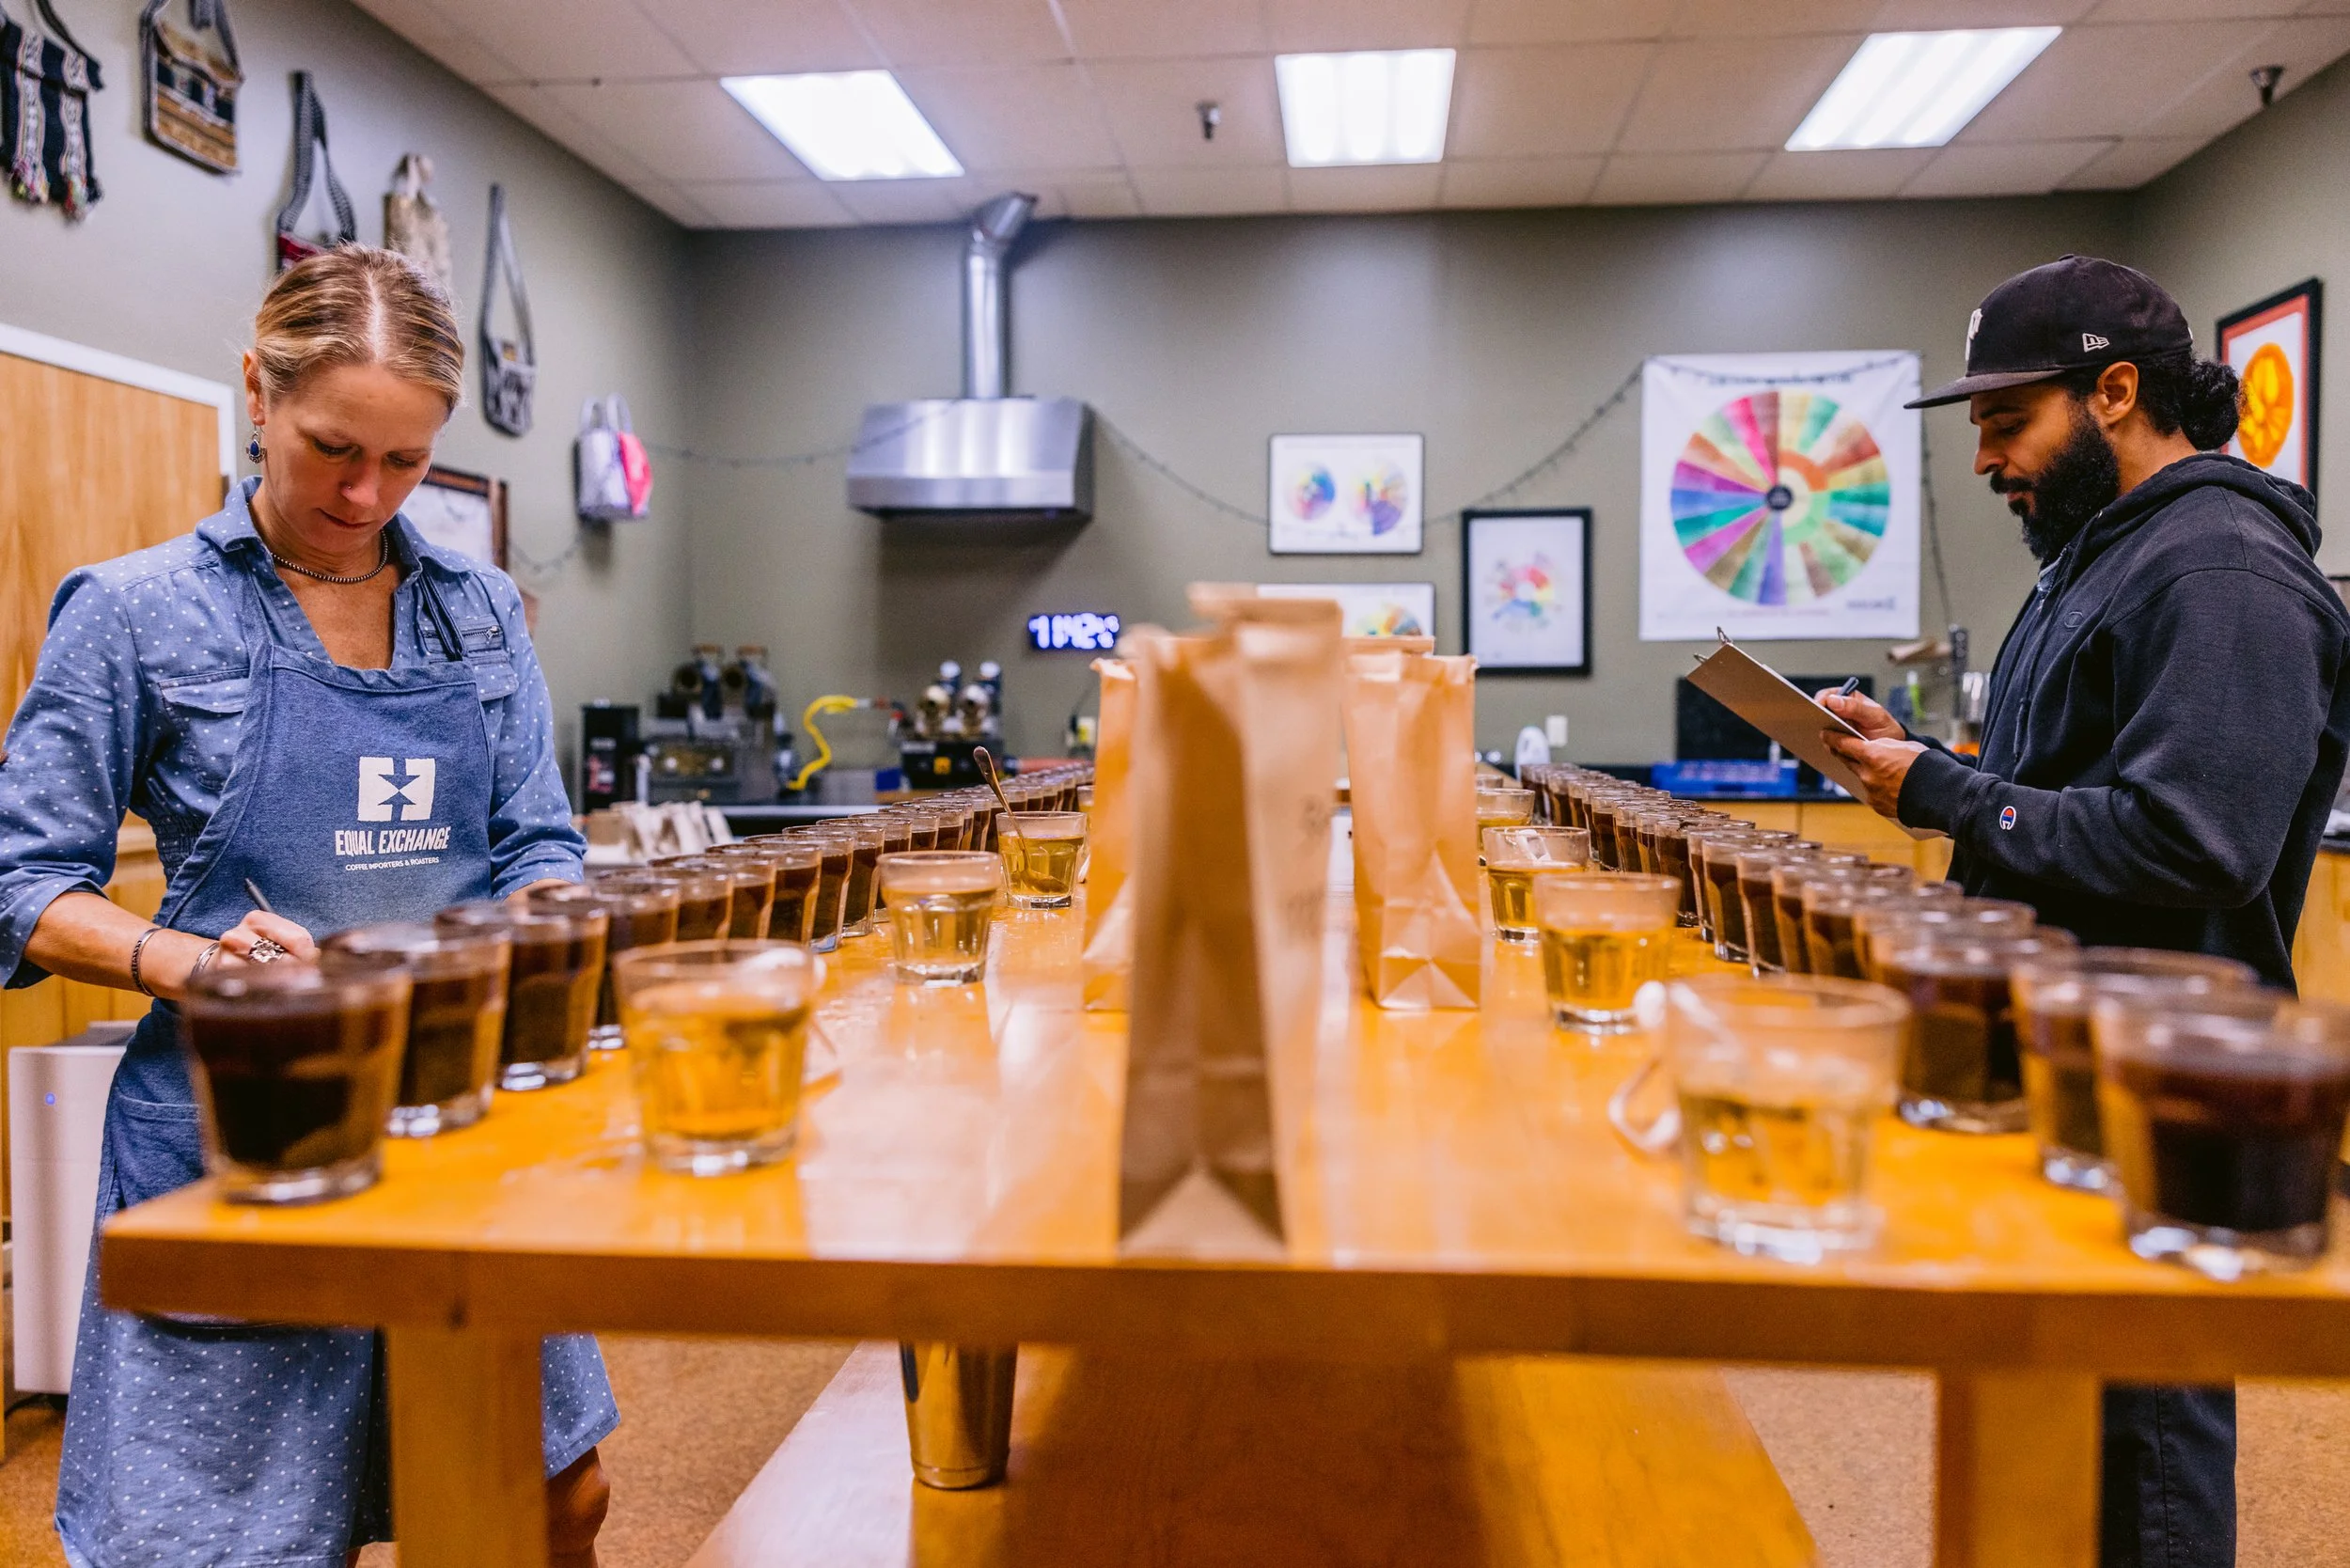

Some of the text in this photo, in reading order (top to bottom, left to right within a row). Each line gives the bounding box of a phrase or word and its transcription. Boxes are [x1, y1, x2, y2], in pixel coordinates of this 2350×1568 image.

[335, 826, 451, 856] EQUAL EXCHANGE
[368, 860, 403, 870] IMPORTERS
